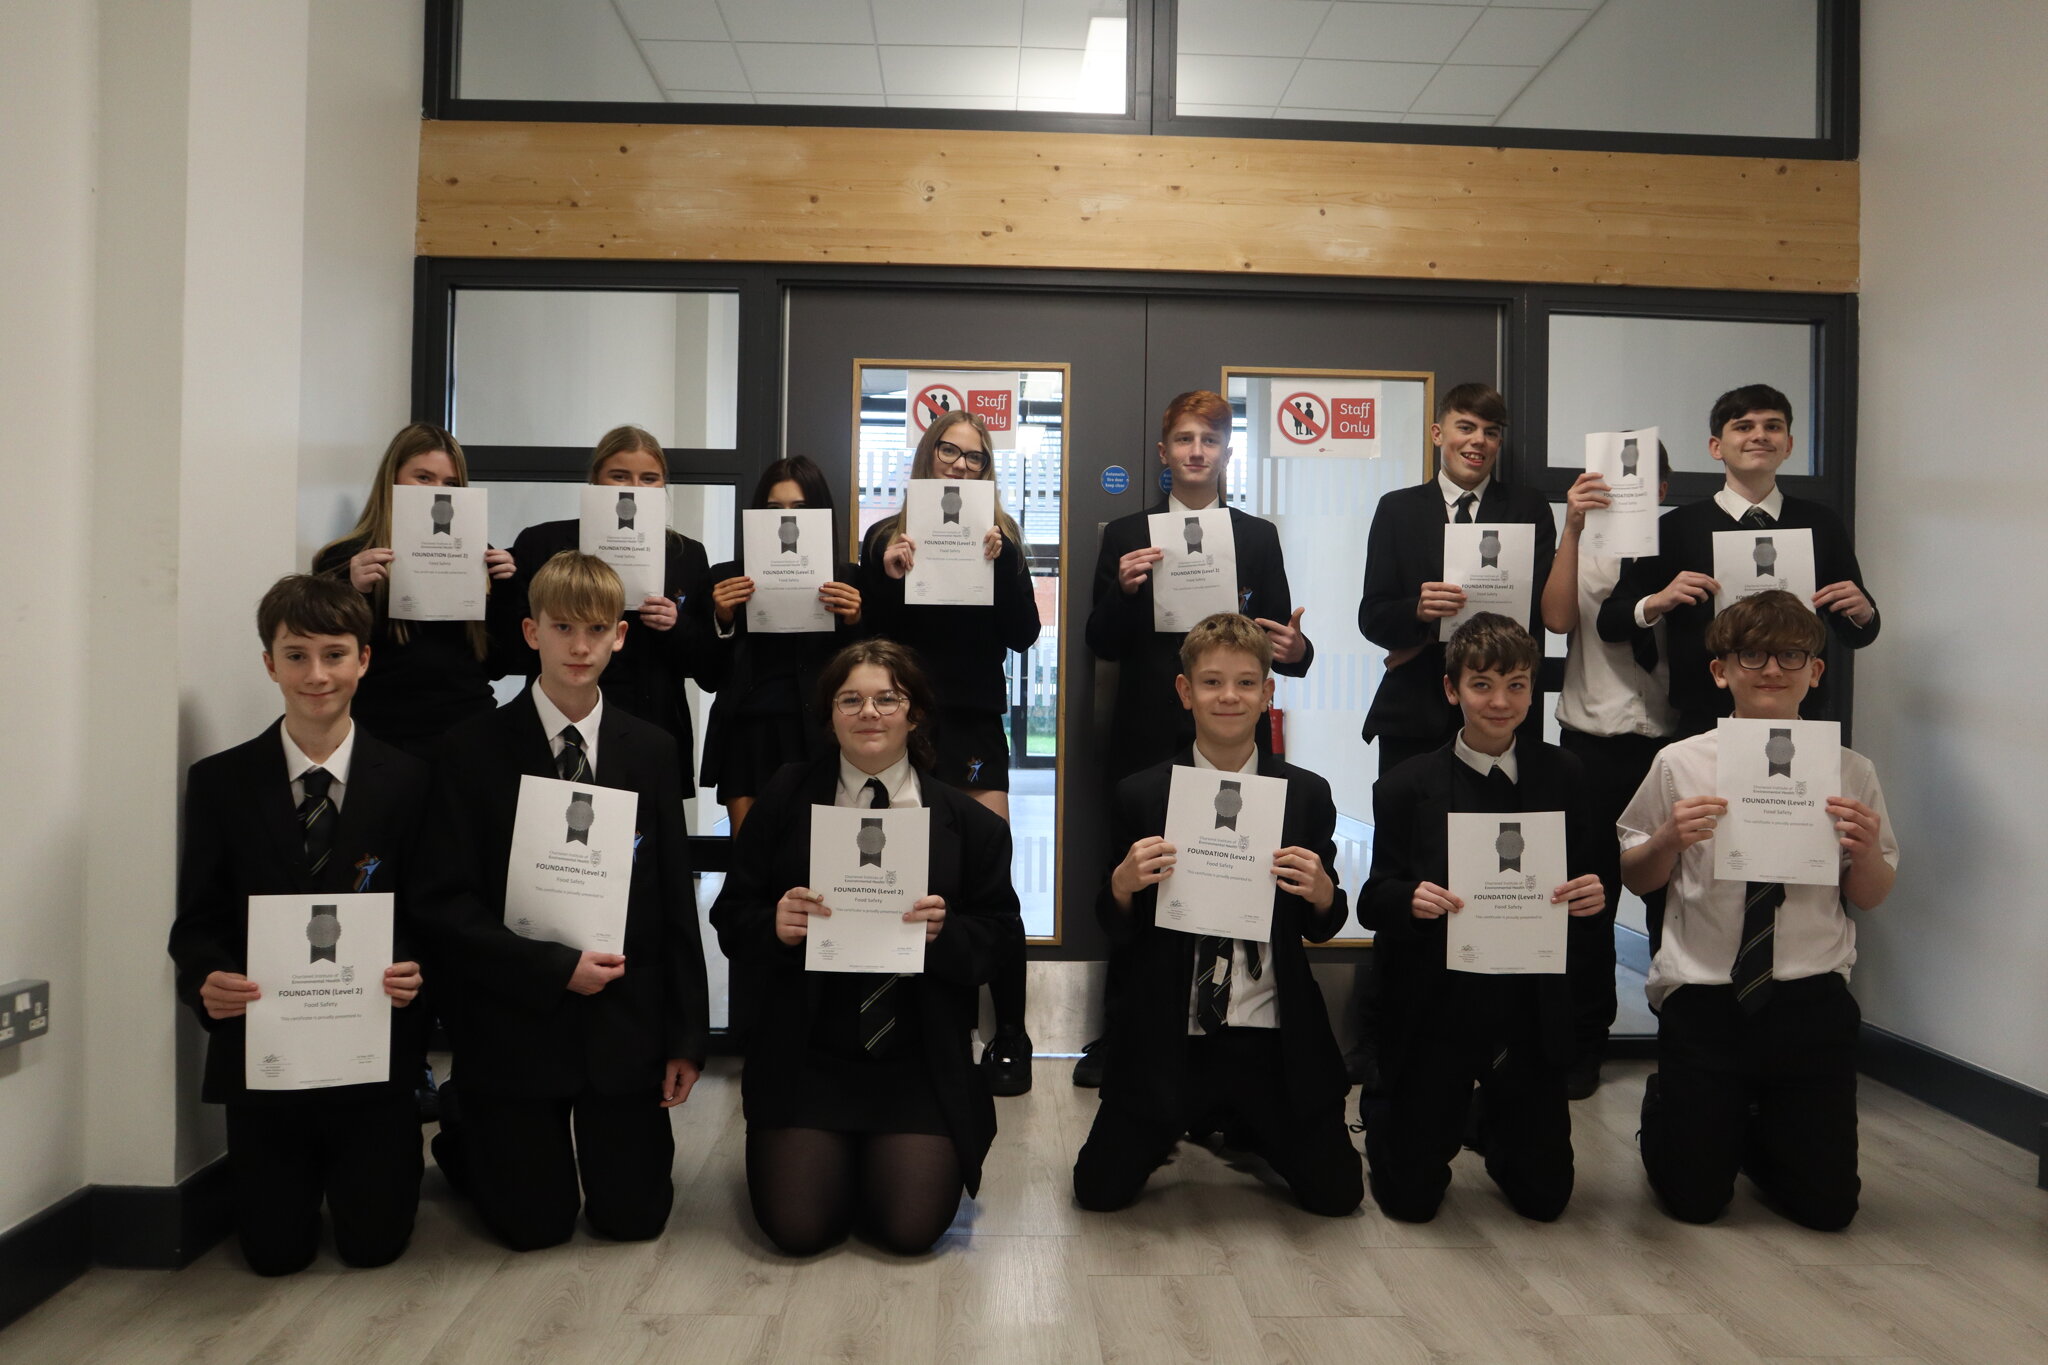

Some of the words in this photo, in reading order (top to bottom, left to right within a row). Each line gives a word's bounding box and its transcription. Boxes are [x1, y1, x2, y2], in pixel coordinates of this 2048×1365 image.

[976, 394, 1007, 410] Staff
[1340, 402, 1370, 418] Staff
[1340, 421, 1369, 436] Only
[1187, 848, 1229, 858] FOUNDATION
[1231, 853, 1248, 862] (Level
[536, 863, 580, 874] FOUNDATION
[581, 868, 600, 877] (Level
[332, 988, 354, 996] (Level
